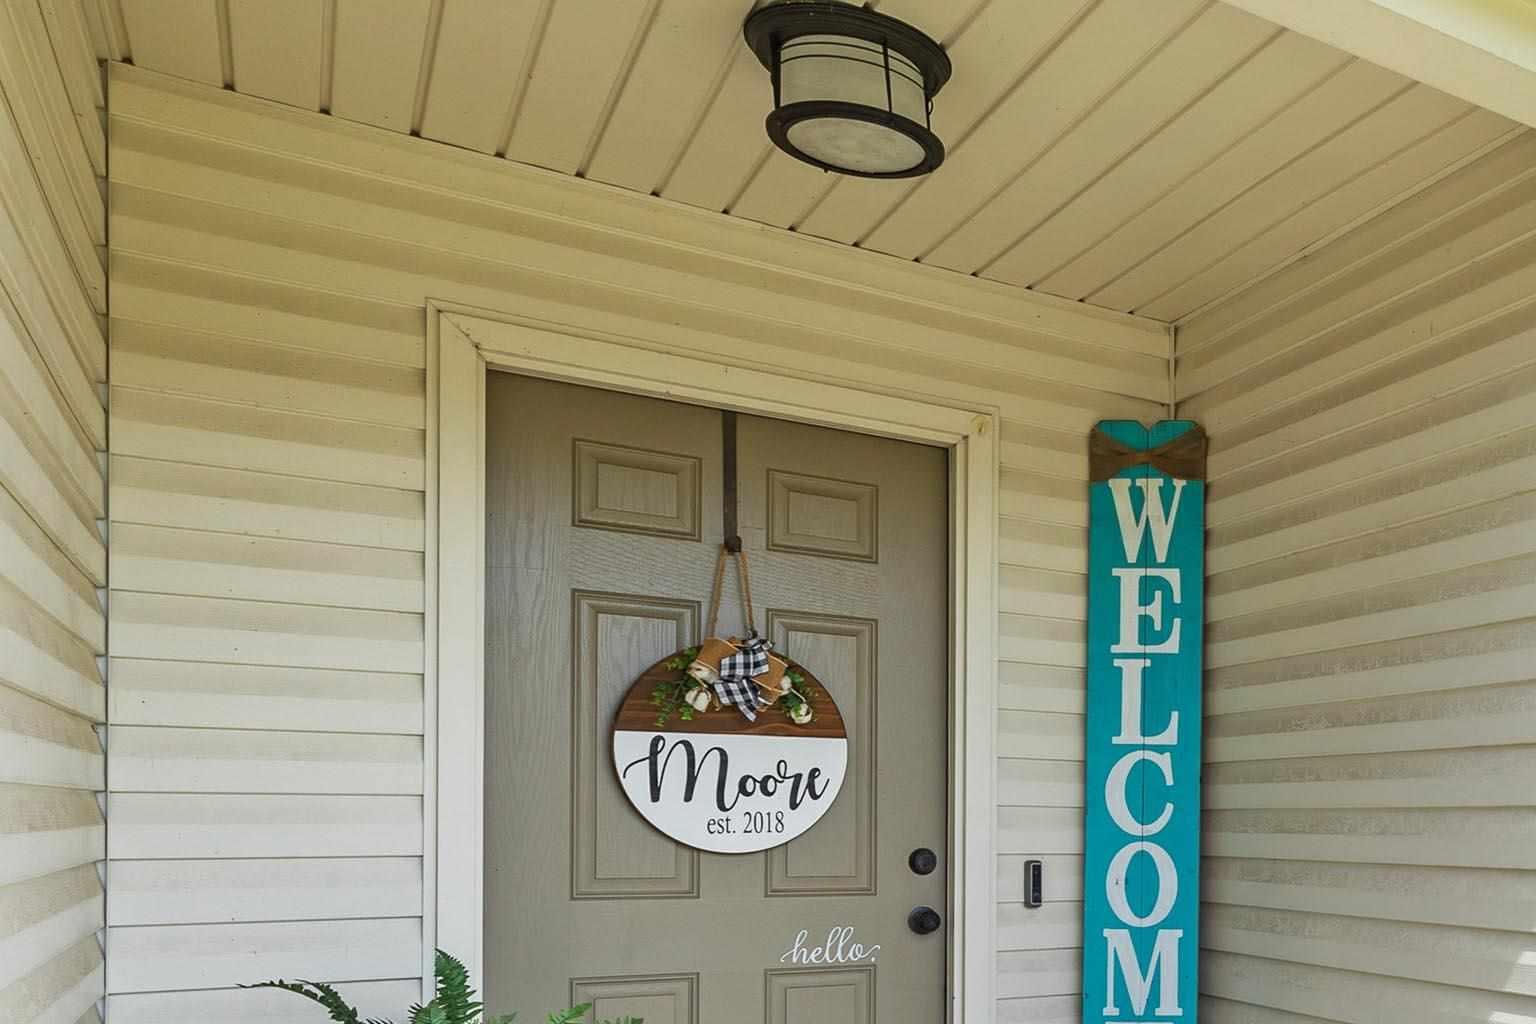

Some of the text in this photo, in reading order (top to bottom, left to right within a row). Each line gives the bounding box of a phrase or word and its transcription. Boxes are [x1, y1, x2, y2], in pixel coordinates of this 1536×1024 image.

[622, 734, 830, 812] Moore
[706, 811, 785, 834] est. 2018
